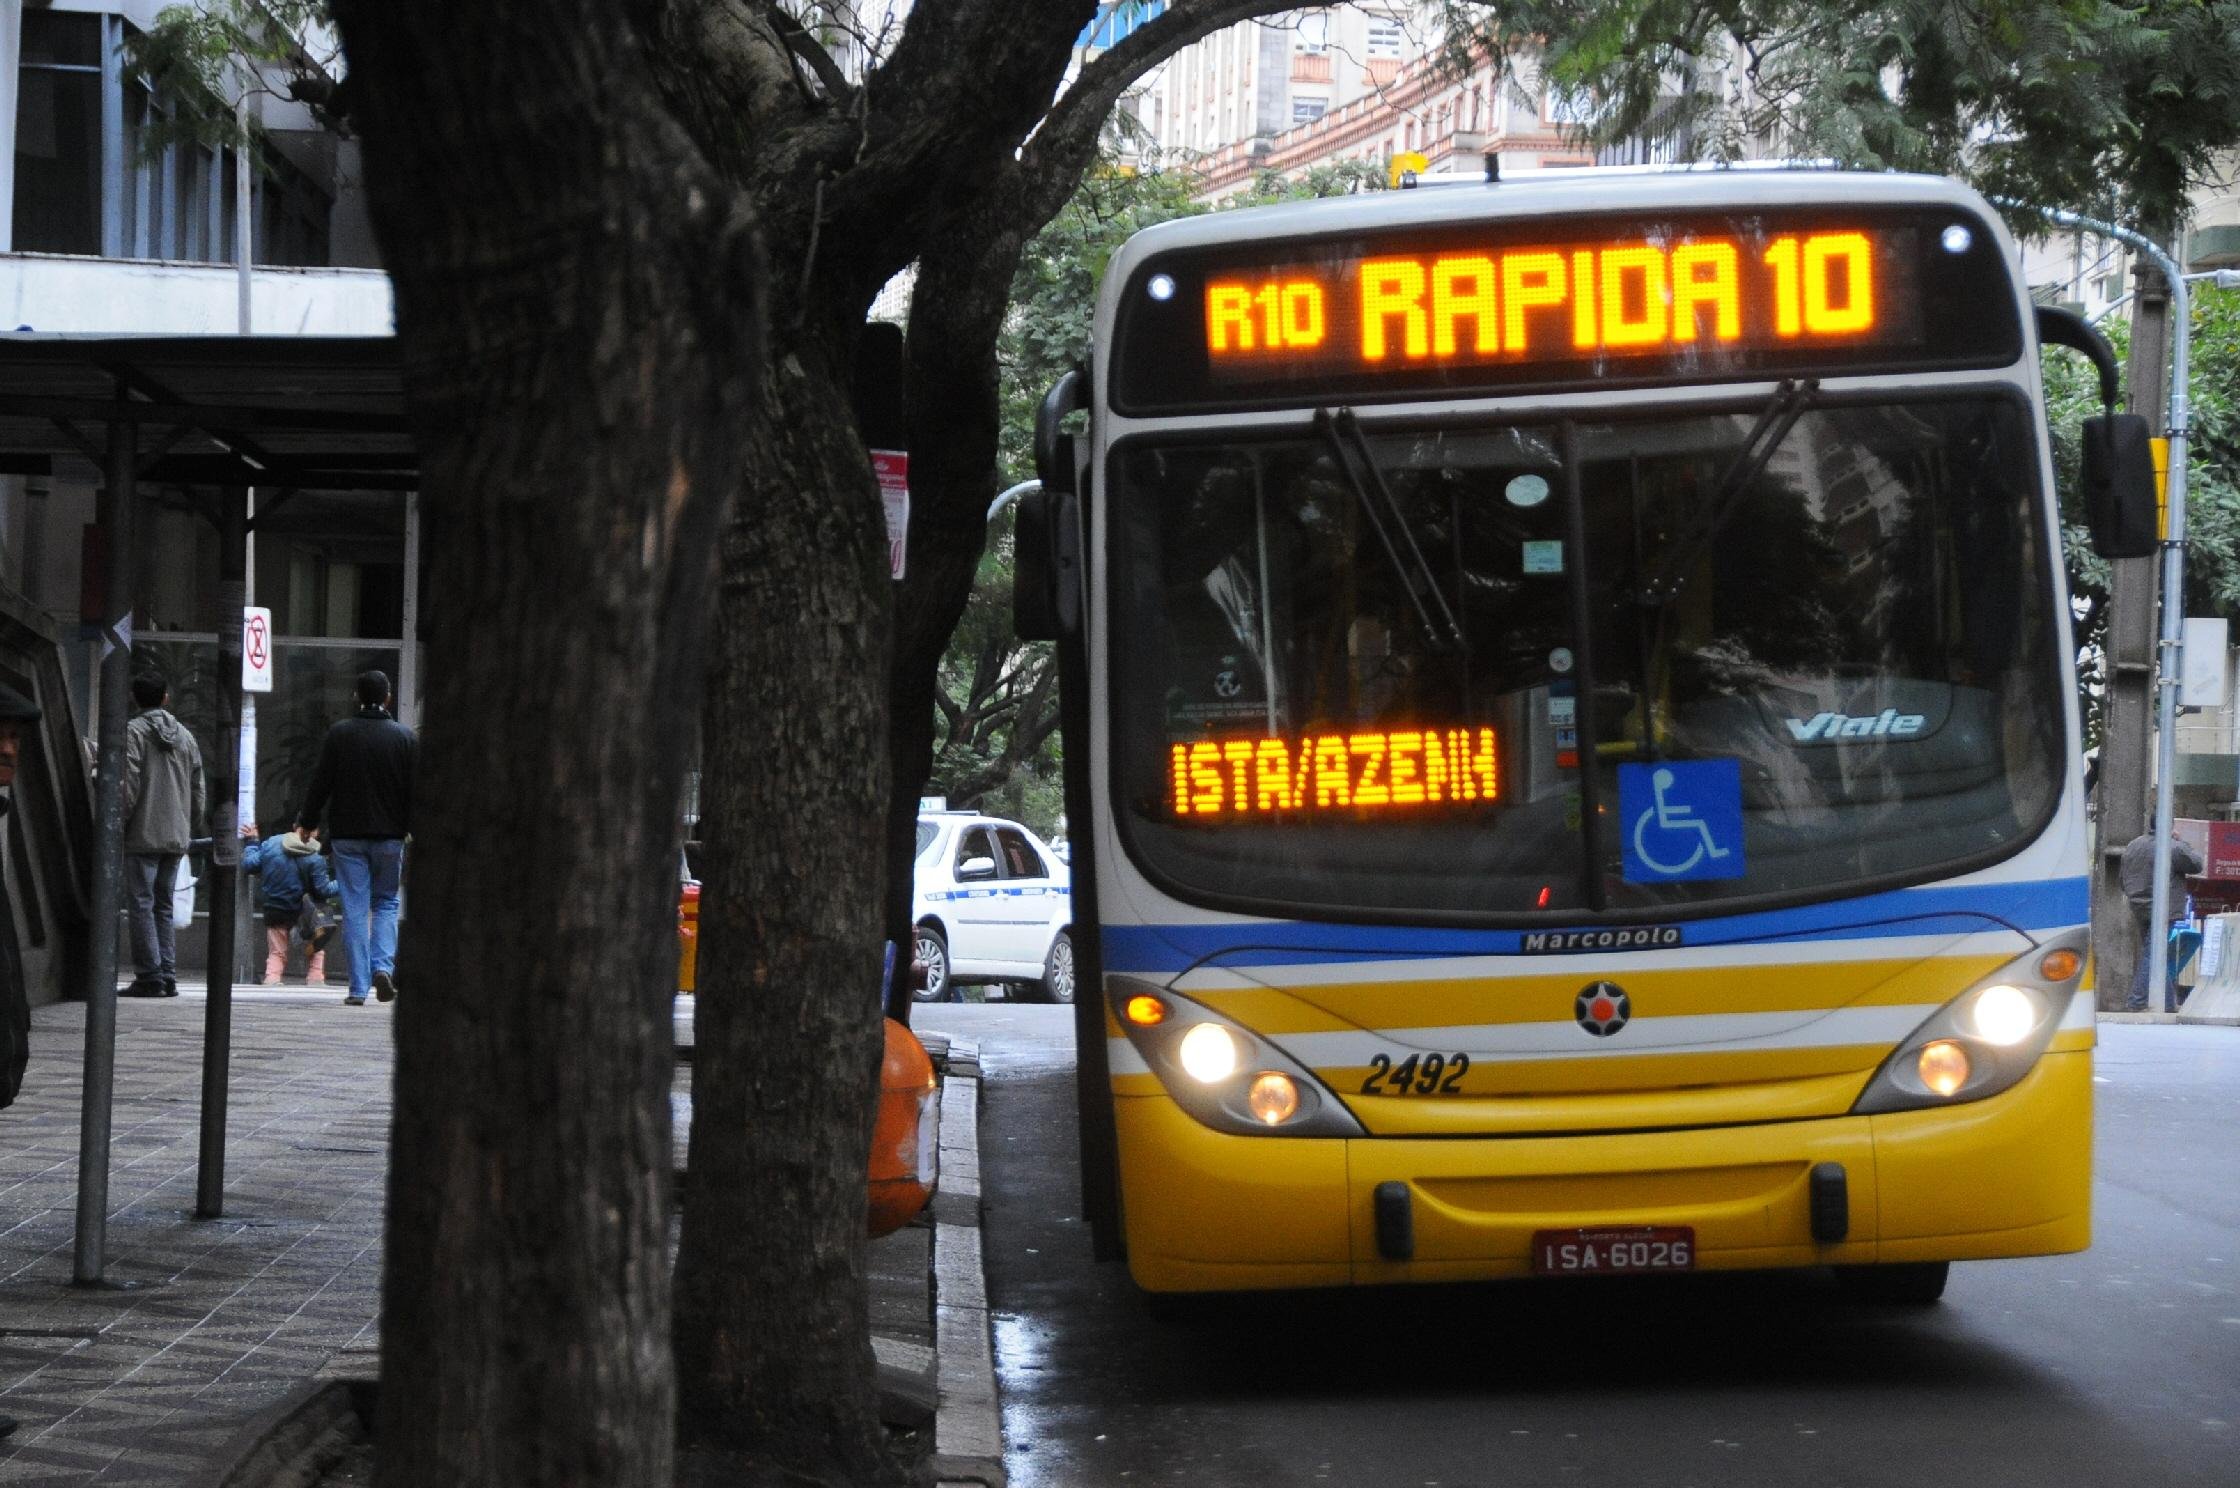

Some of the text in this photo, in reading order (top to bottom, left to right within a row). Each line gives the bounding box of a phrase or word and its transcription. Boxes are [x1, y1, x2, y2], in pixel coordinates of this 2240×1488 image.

[1208, 232, 1873, 360] R10 RAPIDA 10
[1785, 708, 1925, 740] Viale
[1526, 928, 1678, 950] Marcopolo
[1361, 1052, 1469, 1094] 2492
